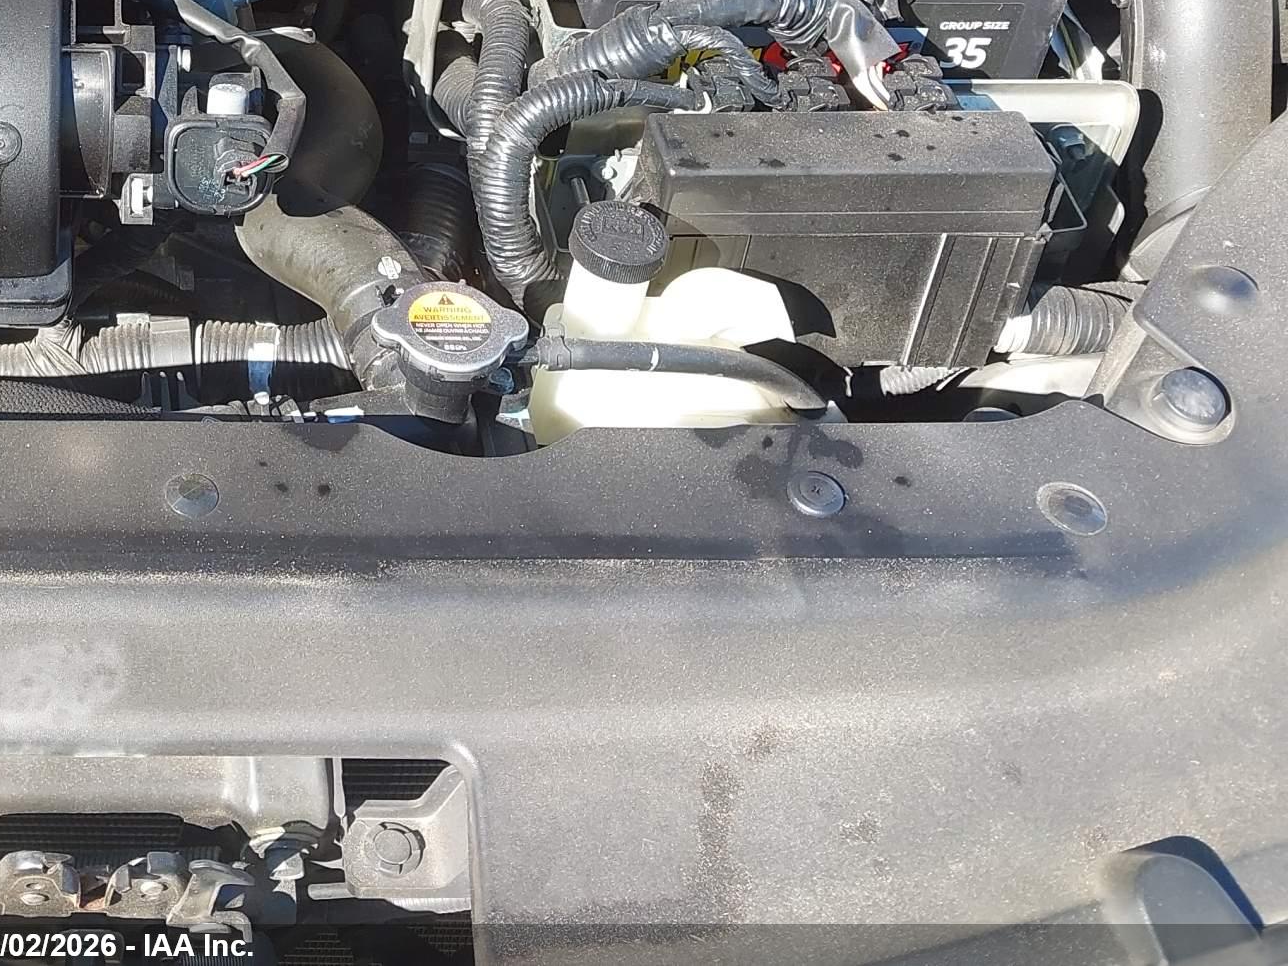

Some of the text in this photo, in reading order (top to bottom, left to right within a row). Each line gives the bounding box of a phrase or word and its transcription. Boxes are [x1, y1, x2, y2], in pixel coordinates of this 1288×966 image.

[939, 21, 1010, 31] GROUP SIZE
[939, 37, 992, 69] 35
